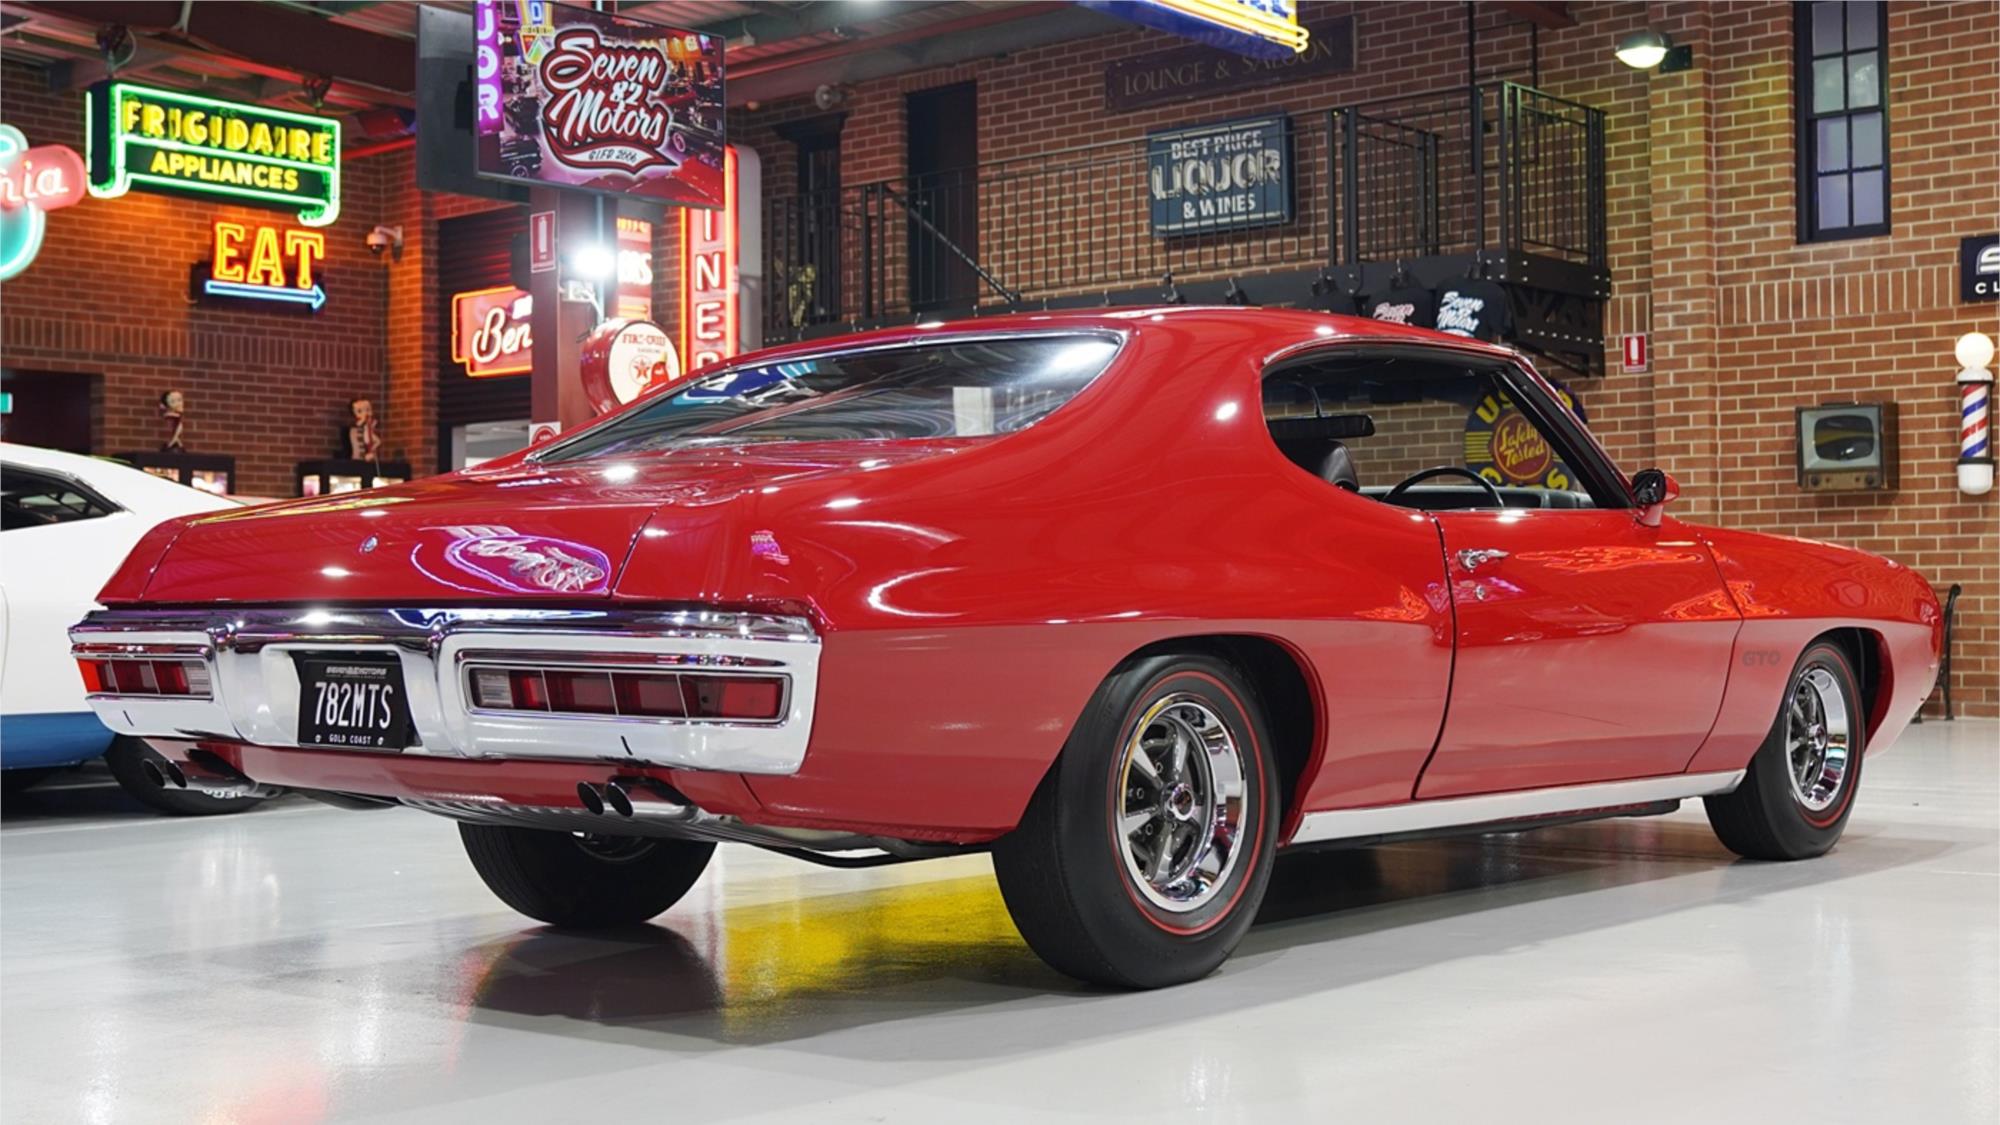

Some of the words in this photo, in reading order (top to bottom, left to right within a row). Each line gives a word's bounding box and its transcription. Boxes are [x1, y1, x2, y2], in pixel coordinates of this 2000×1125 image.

[546, 36, 661, 90] Seven
[1125, 62, 1207, 96] LOUNGE
[1215, 58, 1230, 80] &
[610, 82, 643, 106] 82
[122, 100, 333, 163] FRIGIDAIRE
[549, 88, 664, 142] Motors
[1171, 137, 1211, 160] BEST
[1214, 130, 1263, 153] PRICE
[151, 150, 299, 191] APPLIANCES
[1152, 148, 1281, 200] LIQUOR
[1183, 201, 1196, 219] &
[1199, 193, 1256, 216] WINES
[213, 221, 325, 290] EAT
[1499, 422, 1539, 451] Safety
[1504, 438, 1545, 467] Tested
[1742, 650, 1781, 667] GTO
[315, 682, 393, 729] 782MTS
[329, 734, 346, 743] GOLD
[350, 735, 371, 745] COAST
